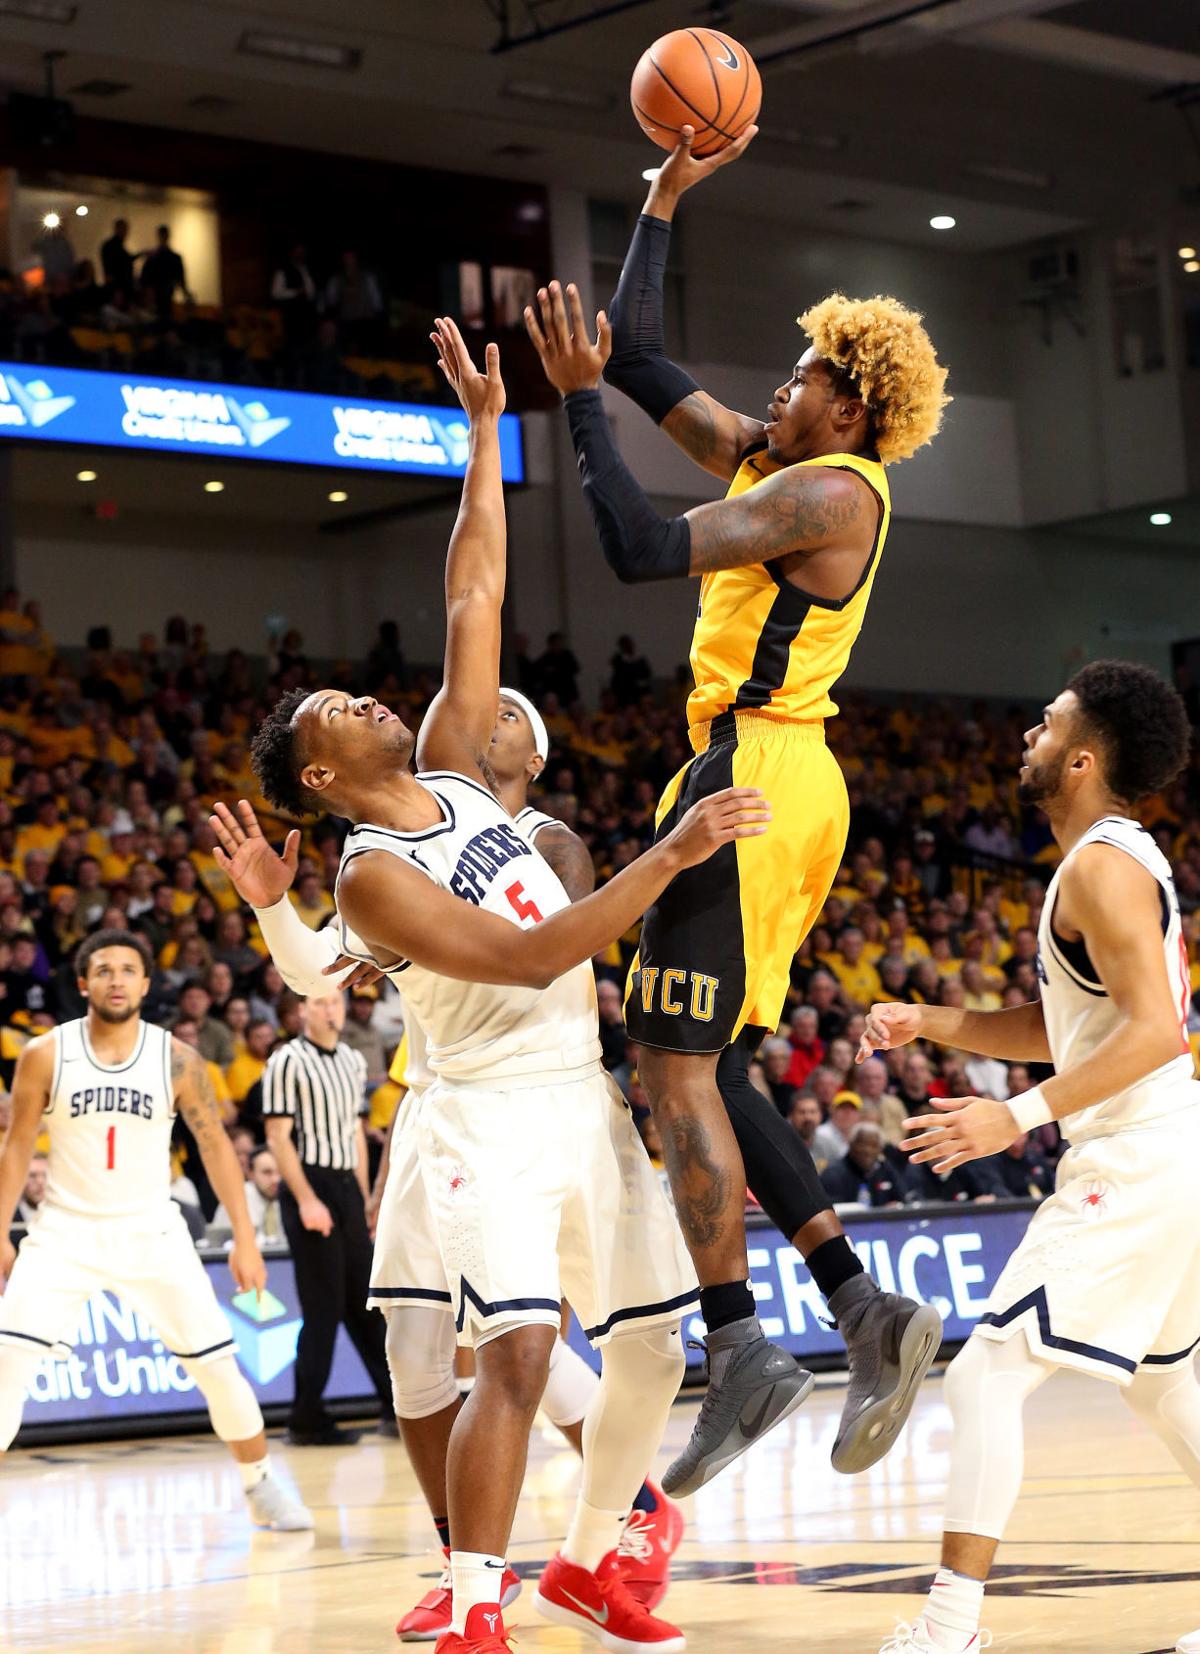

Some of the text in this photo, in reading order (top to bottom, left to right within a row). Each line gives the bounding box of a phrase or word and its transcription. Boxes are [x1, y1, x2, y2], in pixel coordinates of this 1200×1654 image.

[504, 880, 544, 924] 5
[641, 967, 720, 1022] VCU
[70, 1086, 154, 1120] SPIDERS
[106, 1125, 116, 1170] 1
[27, 1345, 198, 1403] dit Unio
